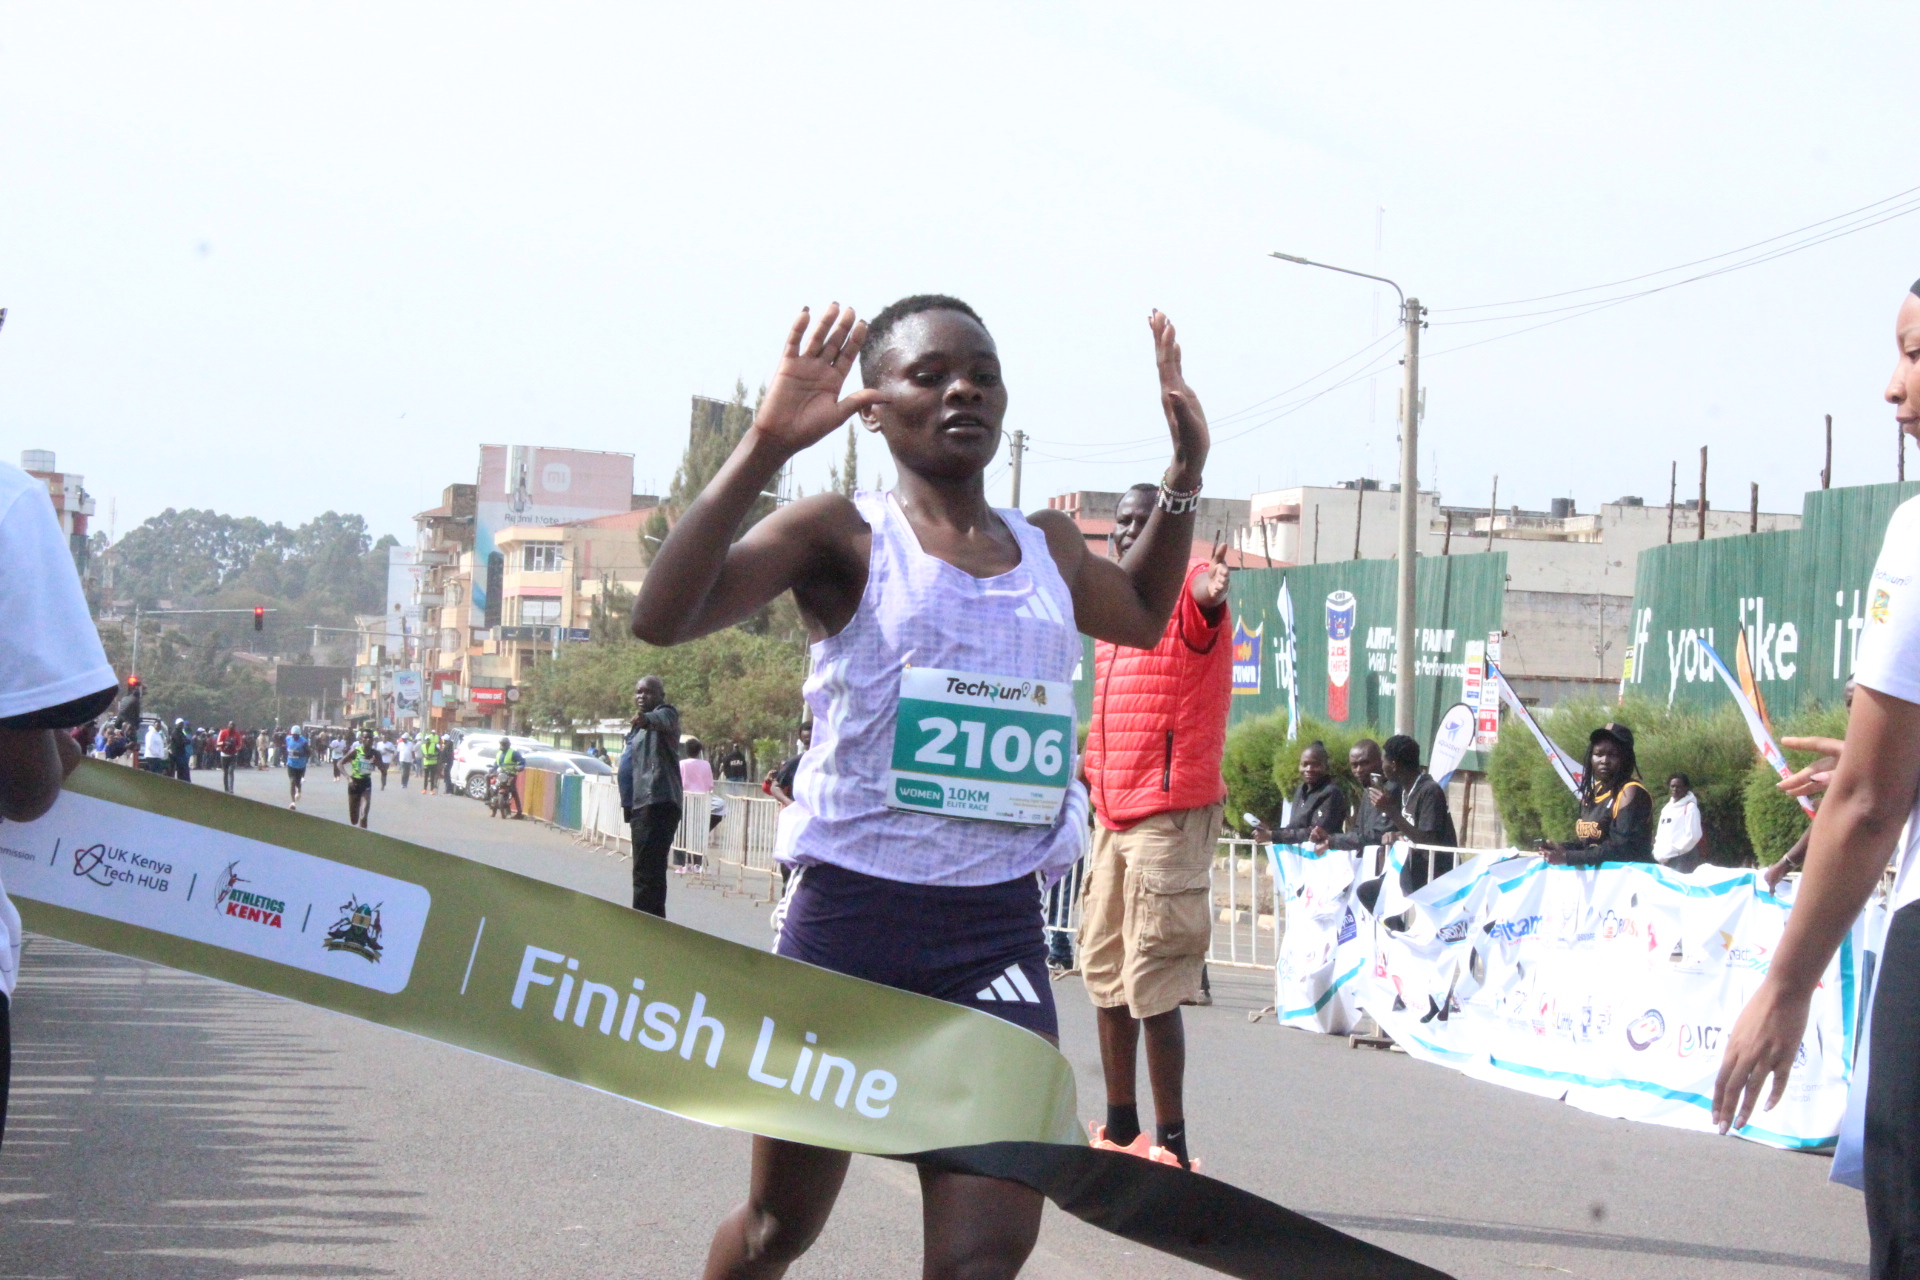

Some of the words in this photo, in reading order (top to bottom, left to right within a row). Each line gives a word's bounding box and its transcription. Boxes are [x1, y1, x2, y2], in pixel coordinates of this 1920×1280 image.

[504, 513, 532, 523] Redmi
[536, 515, 559, 525] Note
[1422, 628, 1455, 653] PAINT
[1630, 607, 1651, 683] If
[1666, 627, 1714, 717] you
[1739, 597, 1798, 681] like
[1232, 665, 1256, 683] rown
[914, 716, 1063, 776] 2106
[899, 786, 940, 801] WOMEN
[948, 787, 990, 804] 10KM
[946, 800, 966, 810] ELITE
[968, 803, 988, 812] RACE
[107, 846, 129, 863] UK
[130, 852, 173, 875] Kenya
[103, 864, 134, 884] Tech
[137, 874, 169, 892] HUB
[228, 888, 286, 914] ATHLETICS
[225, 902, 282, 929] KENYA
[511, 945, 725, 1068] Finish
[747, 1015, 898, 1119] Line
